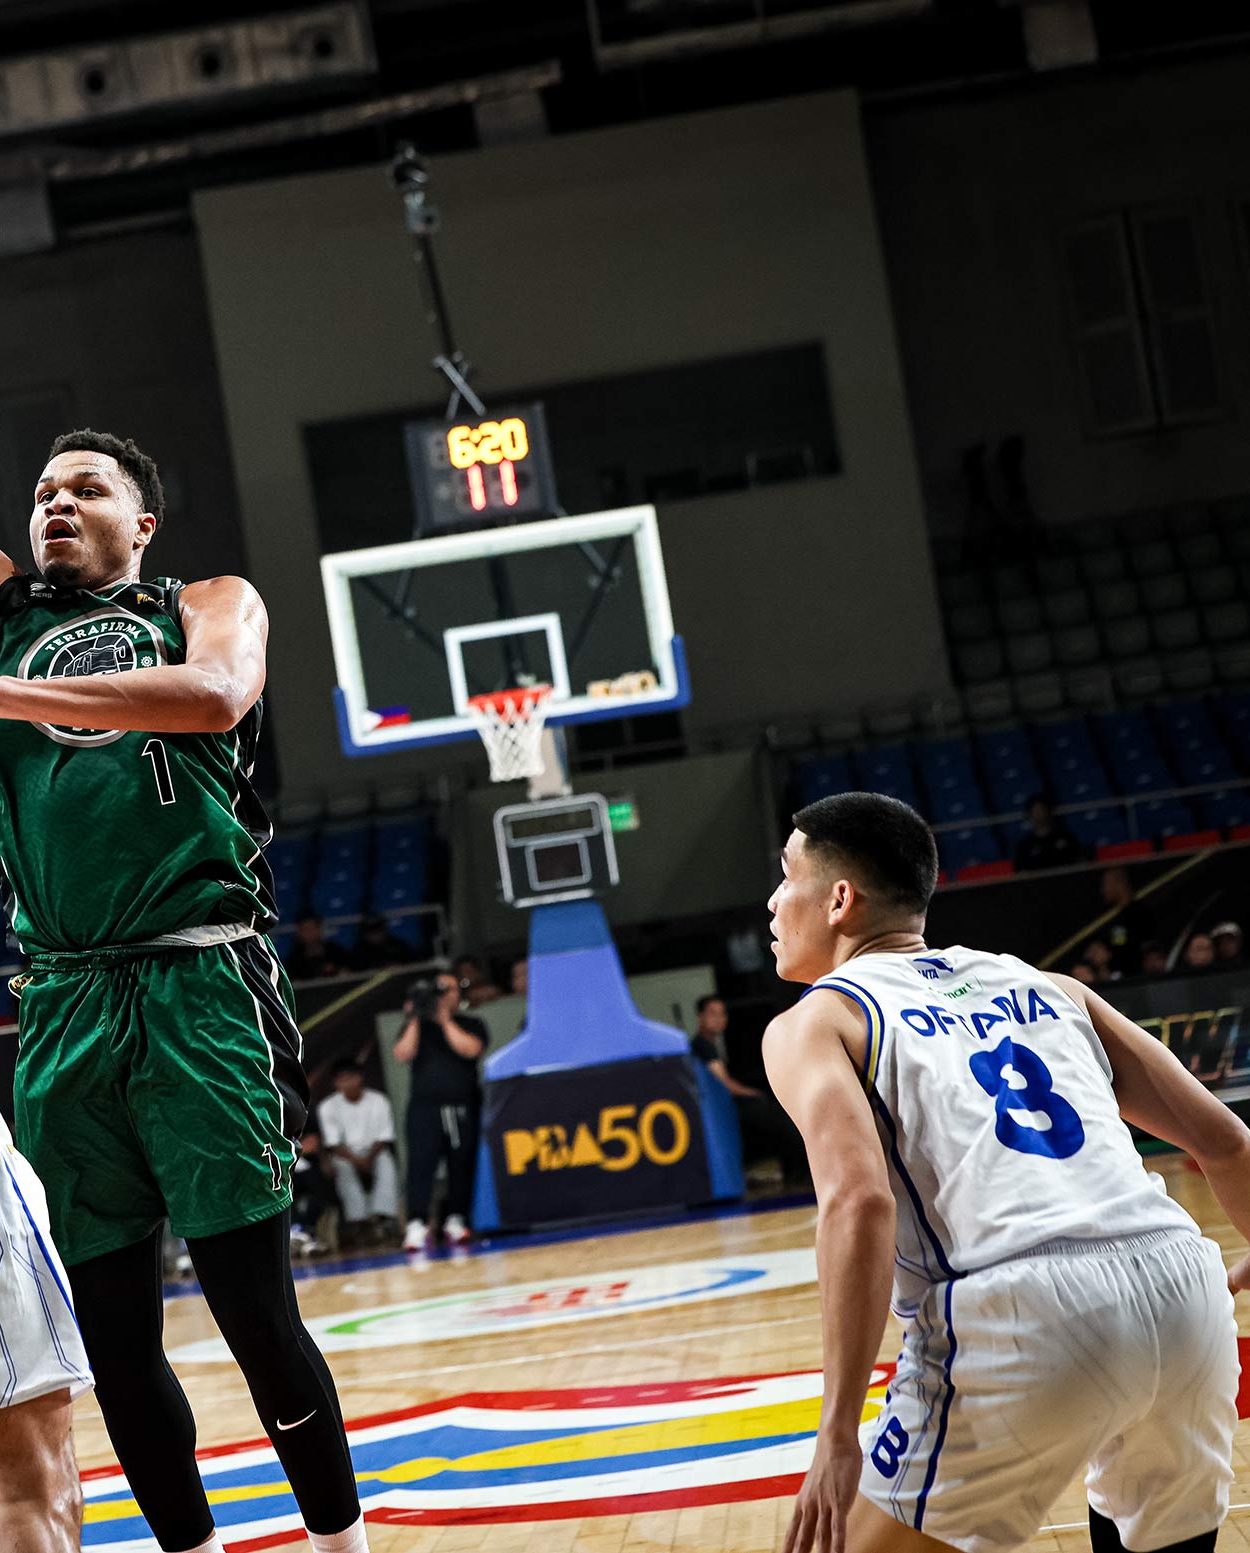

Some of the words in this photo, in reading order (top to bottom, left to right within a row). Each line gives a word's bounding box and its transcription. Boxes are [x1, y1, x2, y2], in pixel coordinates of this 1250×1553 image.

[447, 417, 529, 469] 6:20
[466, 458, 519, 511] 11
[44, 621, 142, 651] TERRAFIRMA
[142, 738, 176, 806] 1
[900, 987, 1061, 1040] OFANA
[969, 1035, 1085, 1160] 8
[261, 1142, 282, 1191] 1
[870, 1415, 910, 1479] 8
